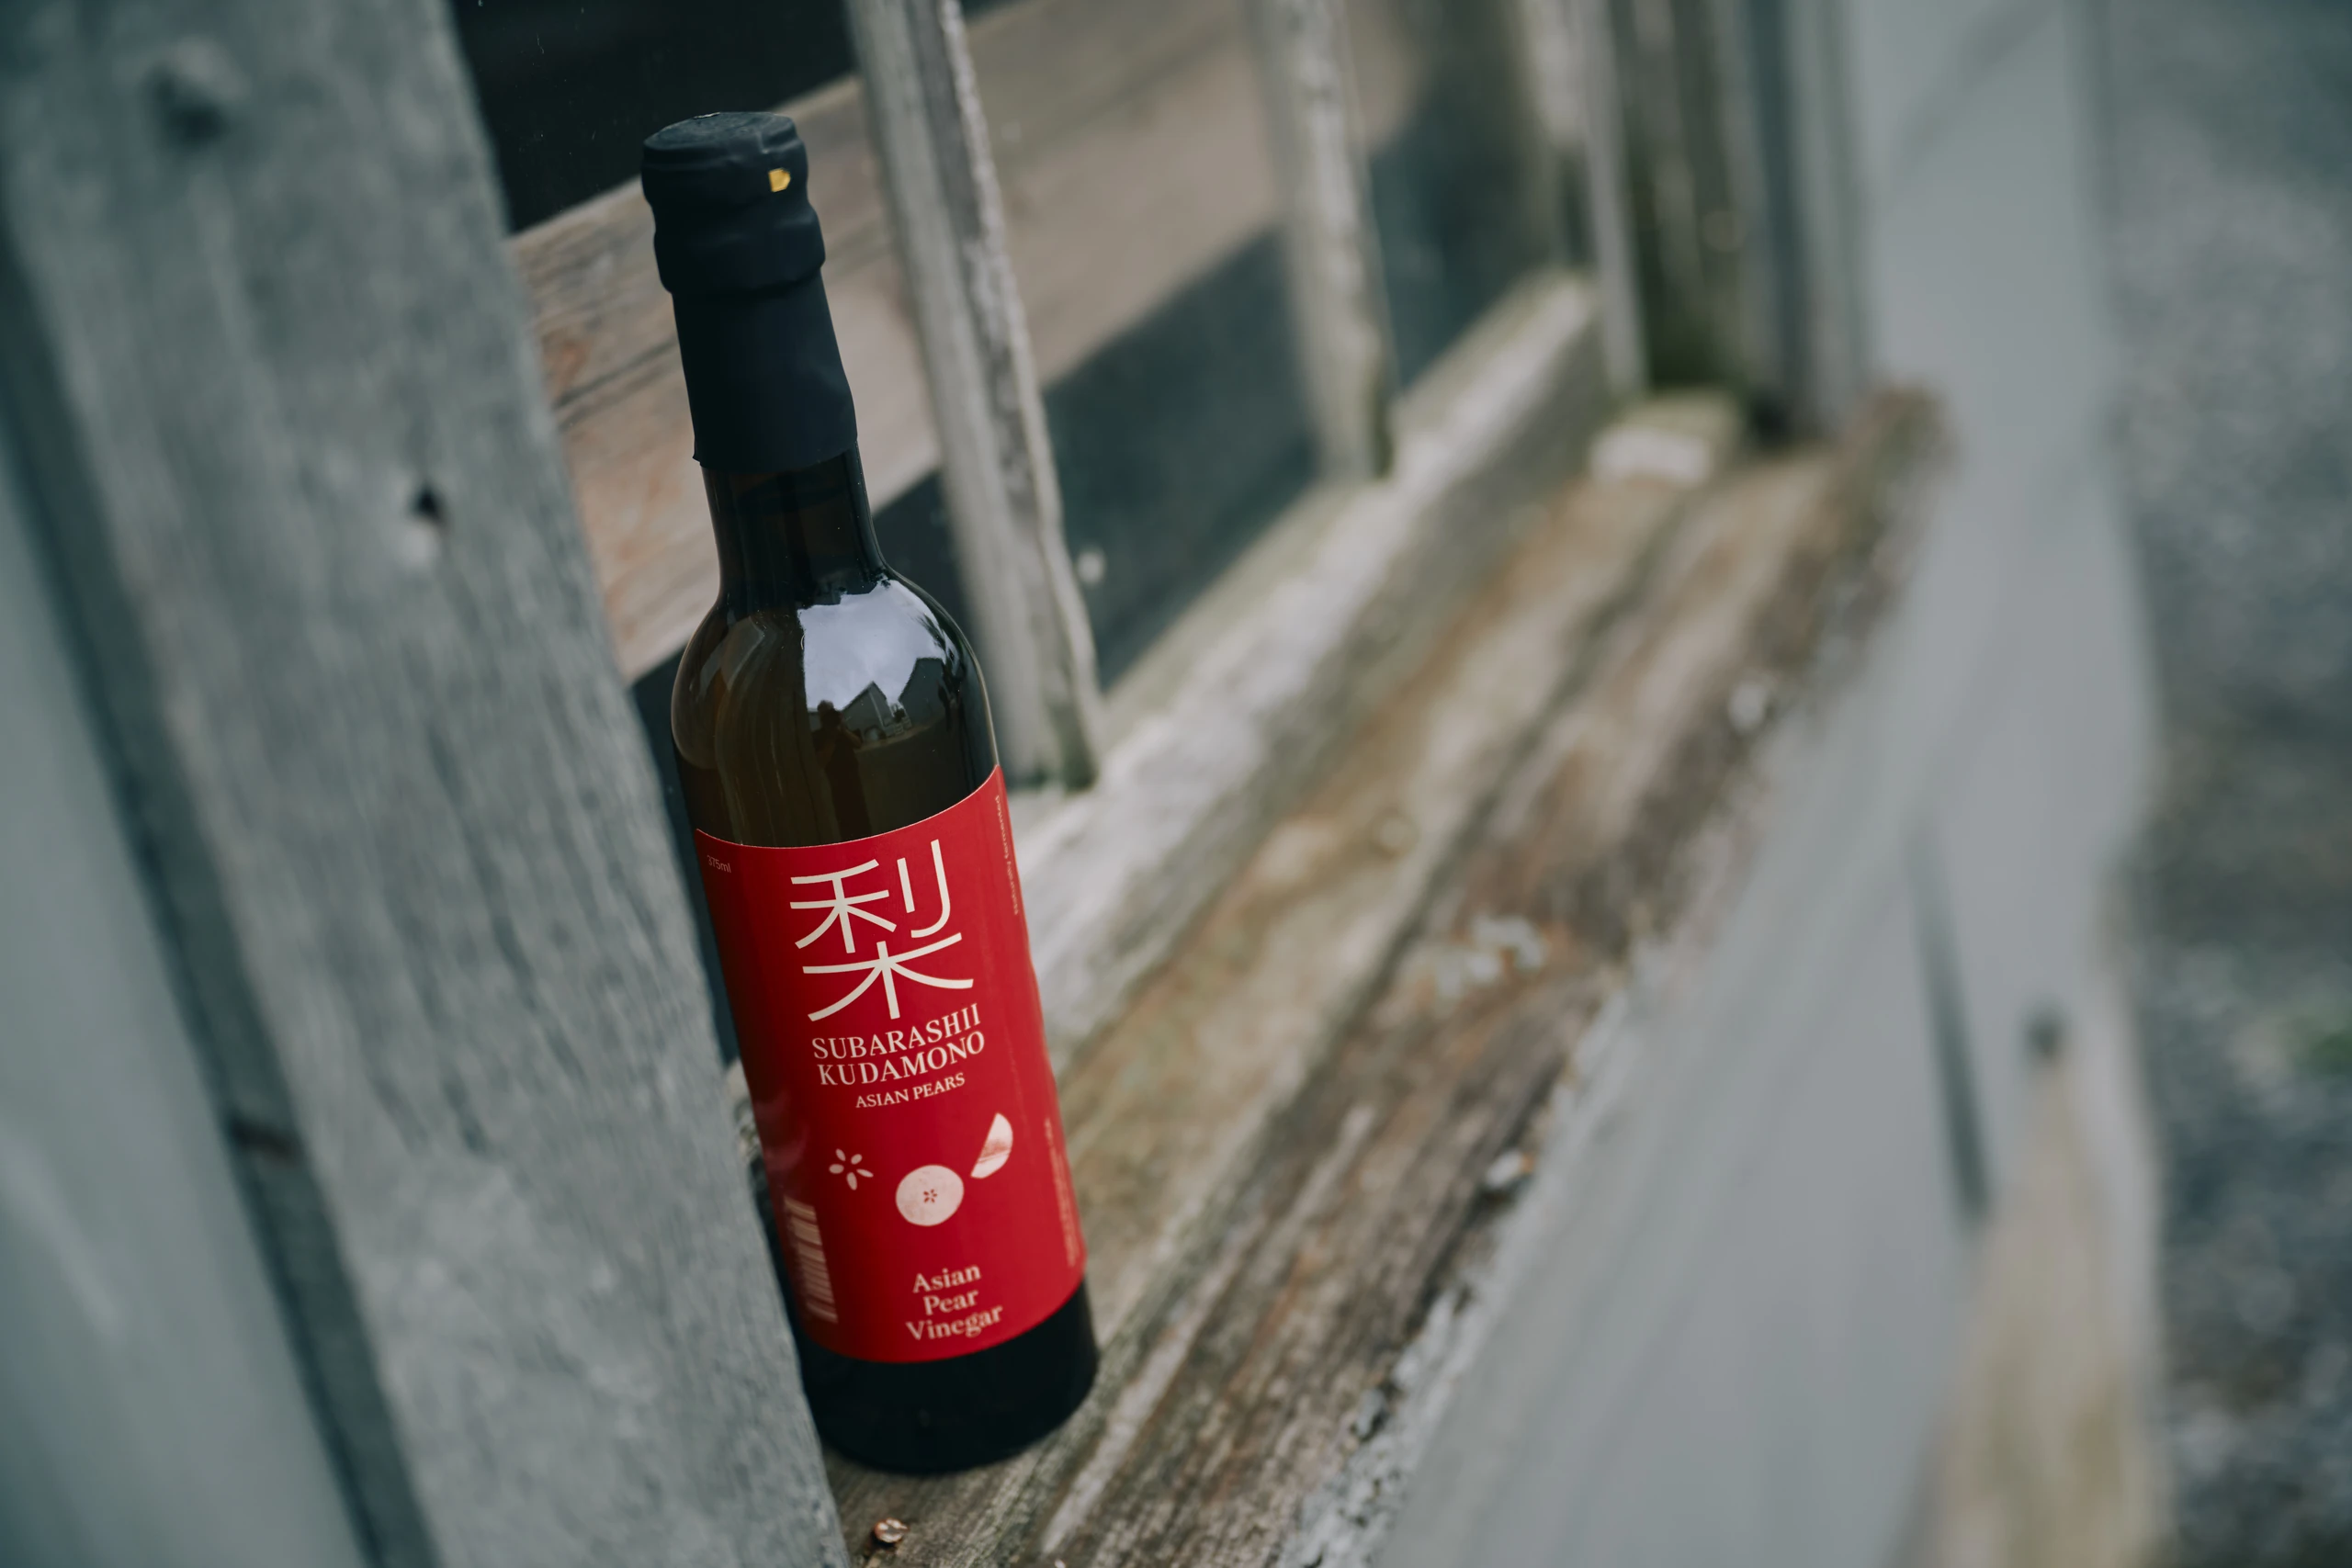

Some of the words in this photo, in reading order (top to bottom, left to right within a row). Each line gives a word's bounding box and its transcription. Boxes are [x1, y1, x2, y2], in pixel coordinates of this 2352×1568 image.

[707, 854, 732, 874] 375ml
[790, 839, 974, 1021] 梨
[811, 1003, 981, 1059] SUBARASHII
[818, 1031, 985, 1086] KUDAMONO
[855, 1089, 910, 1109] ASIAN
[912, 1073, 966, 1100] PEARS
[913, 1265, 981, 1293] Asian
[923, 1291, 978, 1315] Pear
[906, 1306, 1003, 1340] Vinegar
